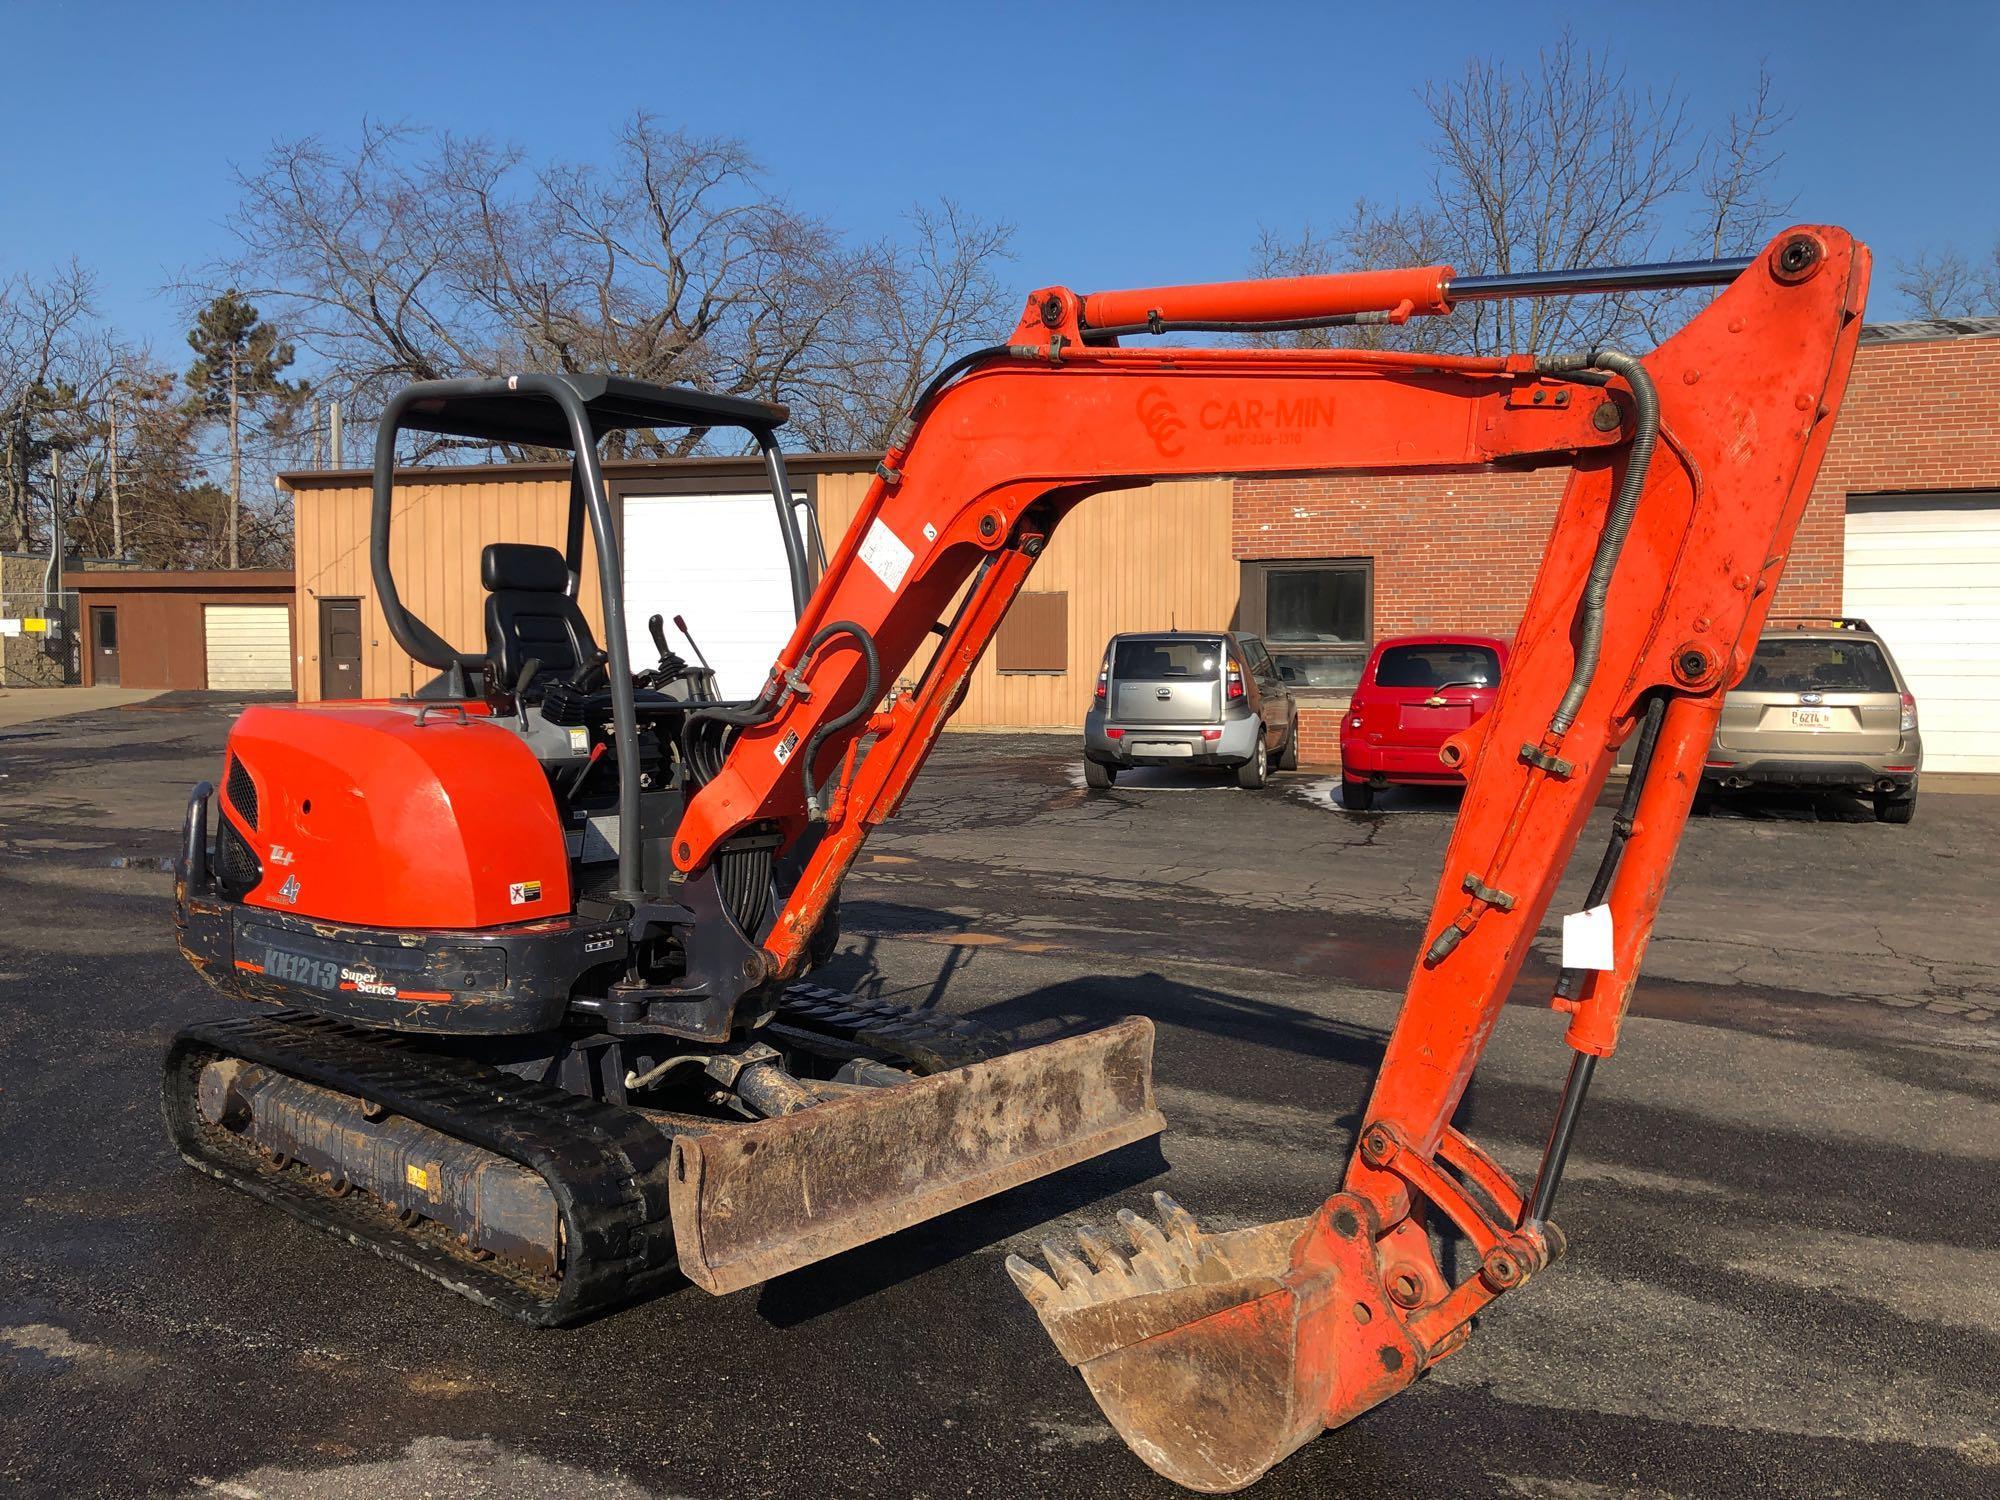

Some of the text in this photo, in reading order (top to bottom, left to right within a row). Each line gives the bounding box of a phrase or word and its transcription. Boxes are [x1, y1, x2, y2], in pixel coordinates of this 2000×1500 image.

[1199, 396, 1336, 430] CAR-MIN
[264, 949, 338, 990] KX121-3
[340, 968, 377, 983] Super
[357, 982, 397, 996] Series
